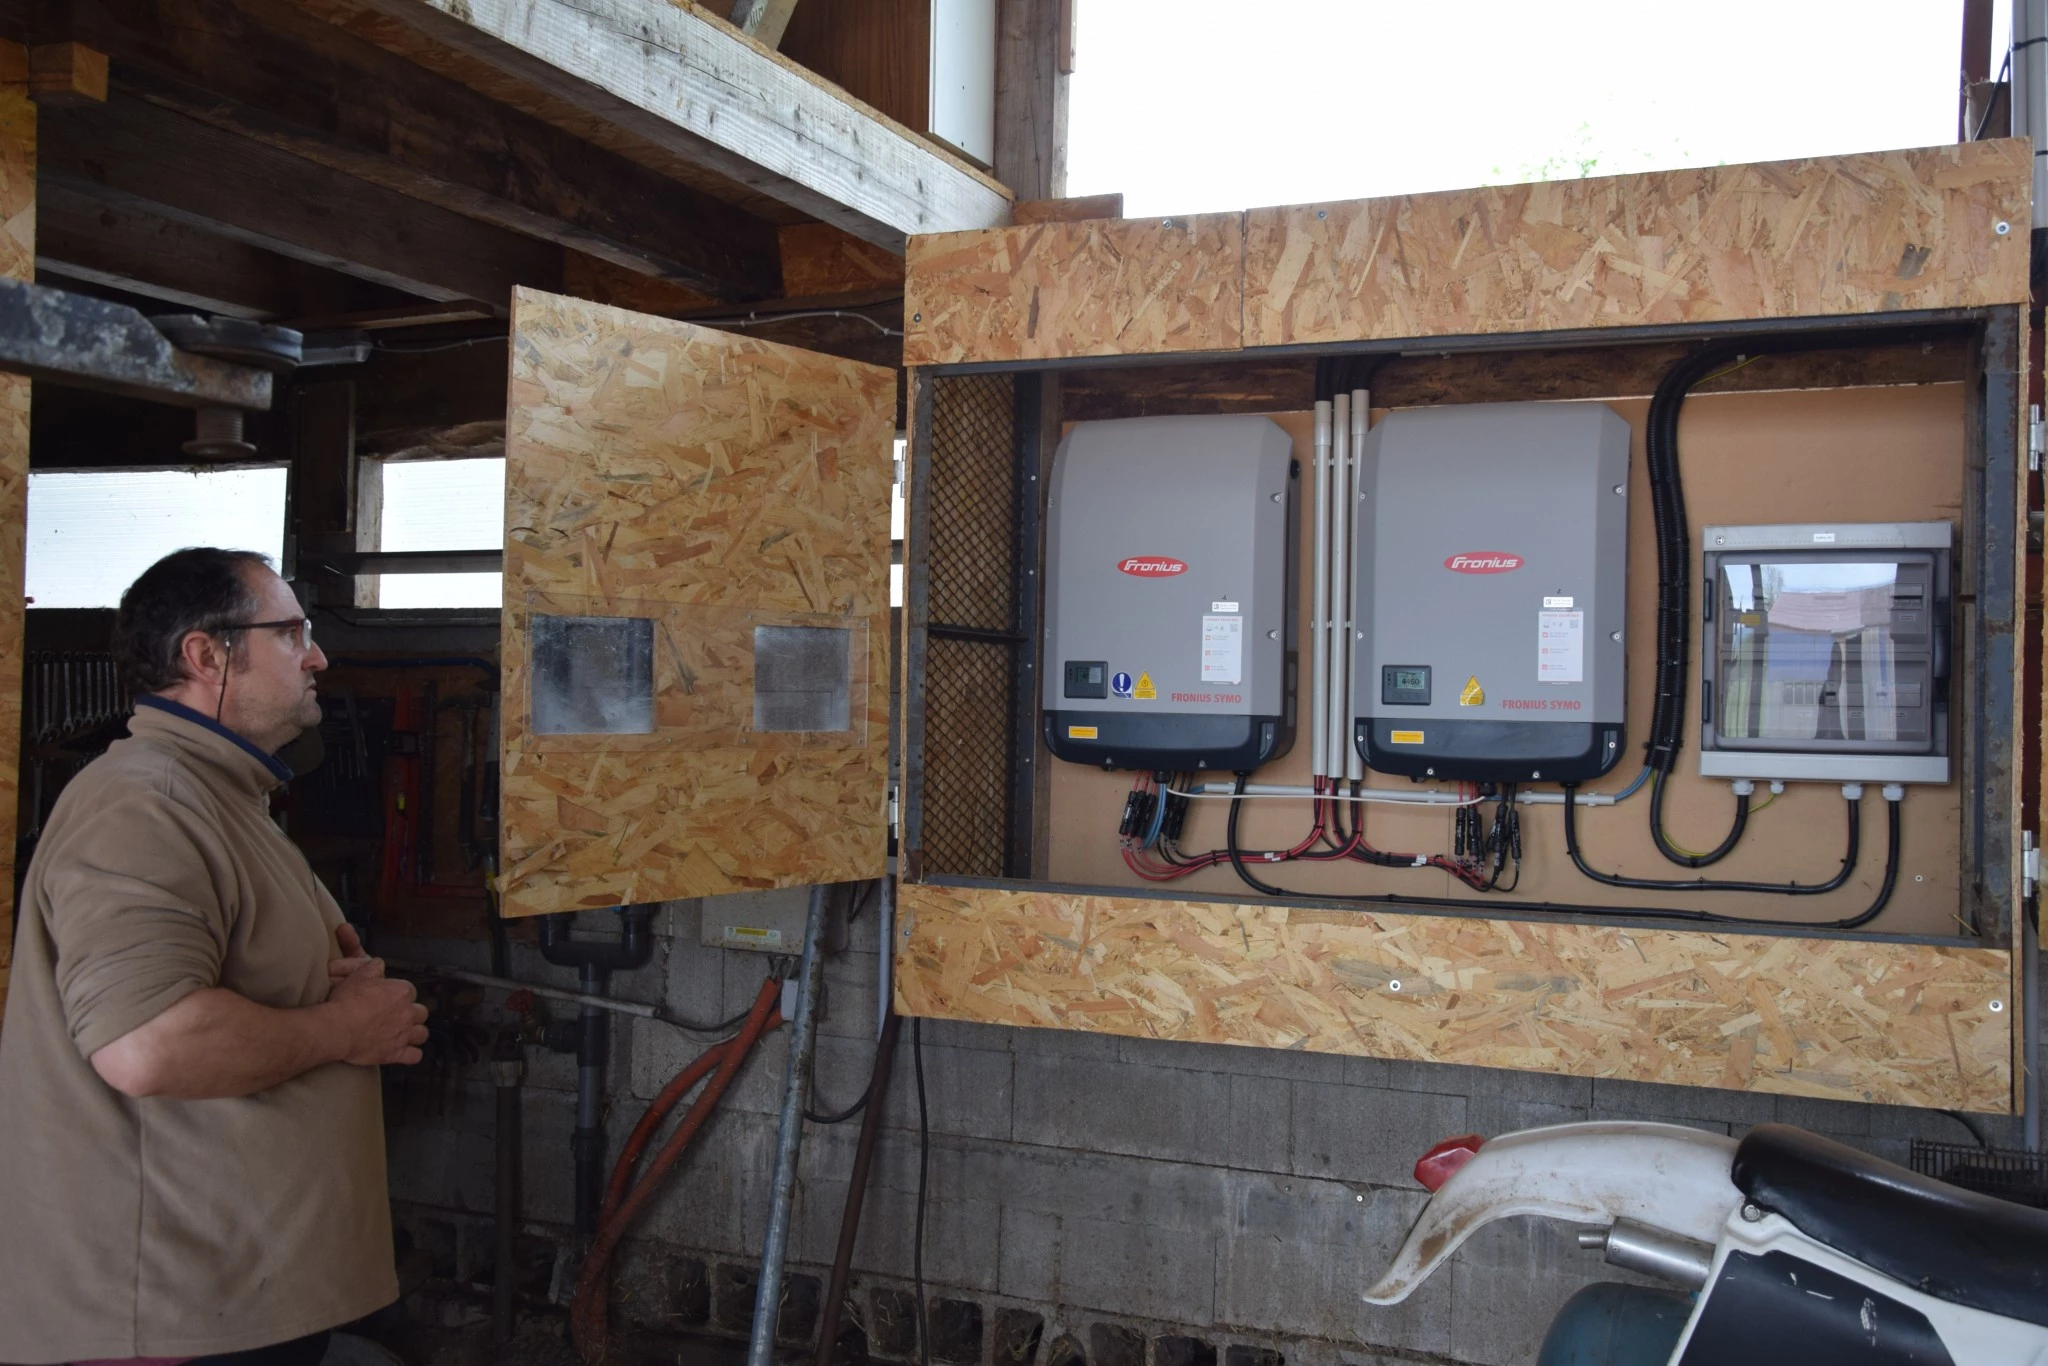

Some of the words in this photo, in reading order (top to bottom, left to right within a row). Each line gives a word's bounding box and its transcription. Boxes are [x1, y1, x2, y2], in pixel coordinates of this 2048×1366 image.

[1123, 560, 1183, 572] Fronius
[1451, 556, 1518, 569] Fronius
[1171, 693, 1211, 703] FRONIUS
[1214, 693, 1242, 704] SYMO
[1502, 699, 1547, 710] FRONIUS
[1550, 700, 1581, 711] SYMO
